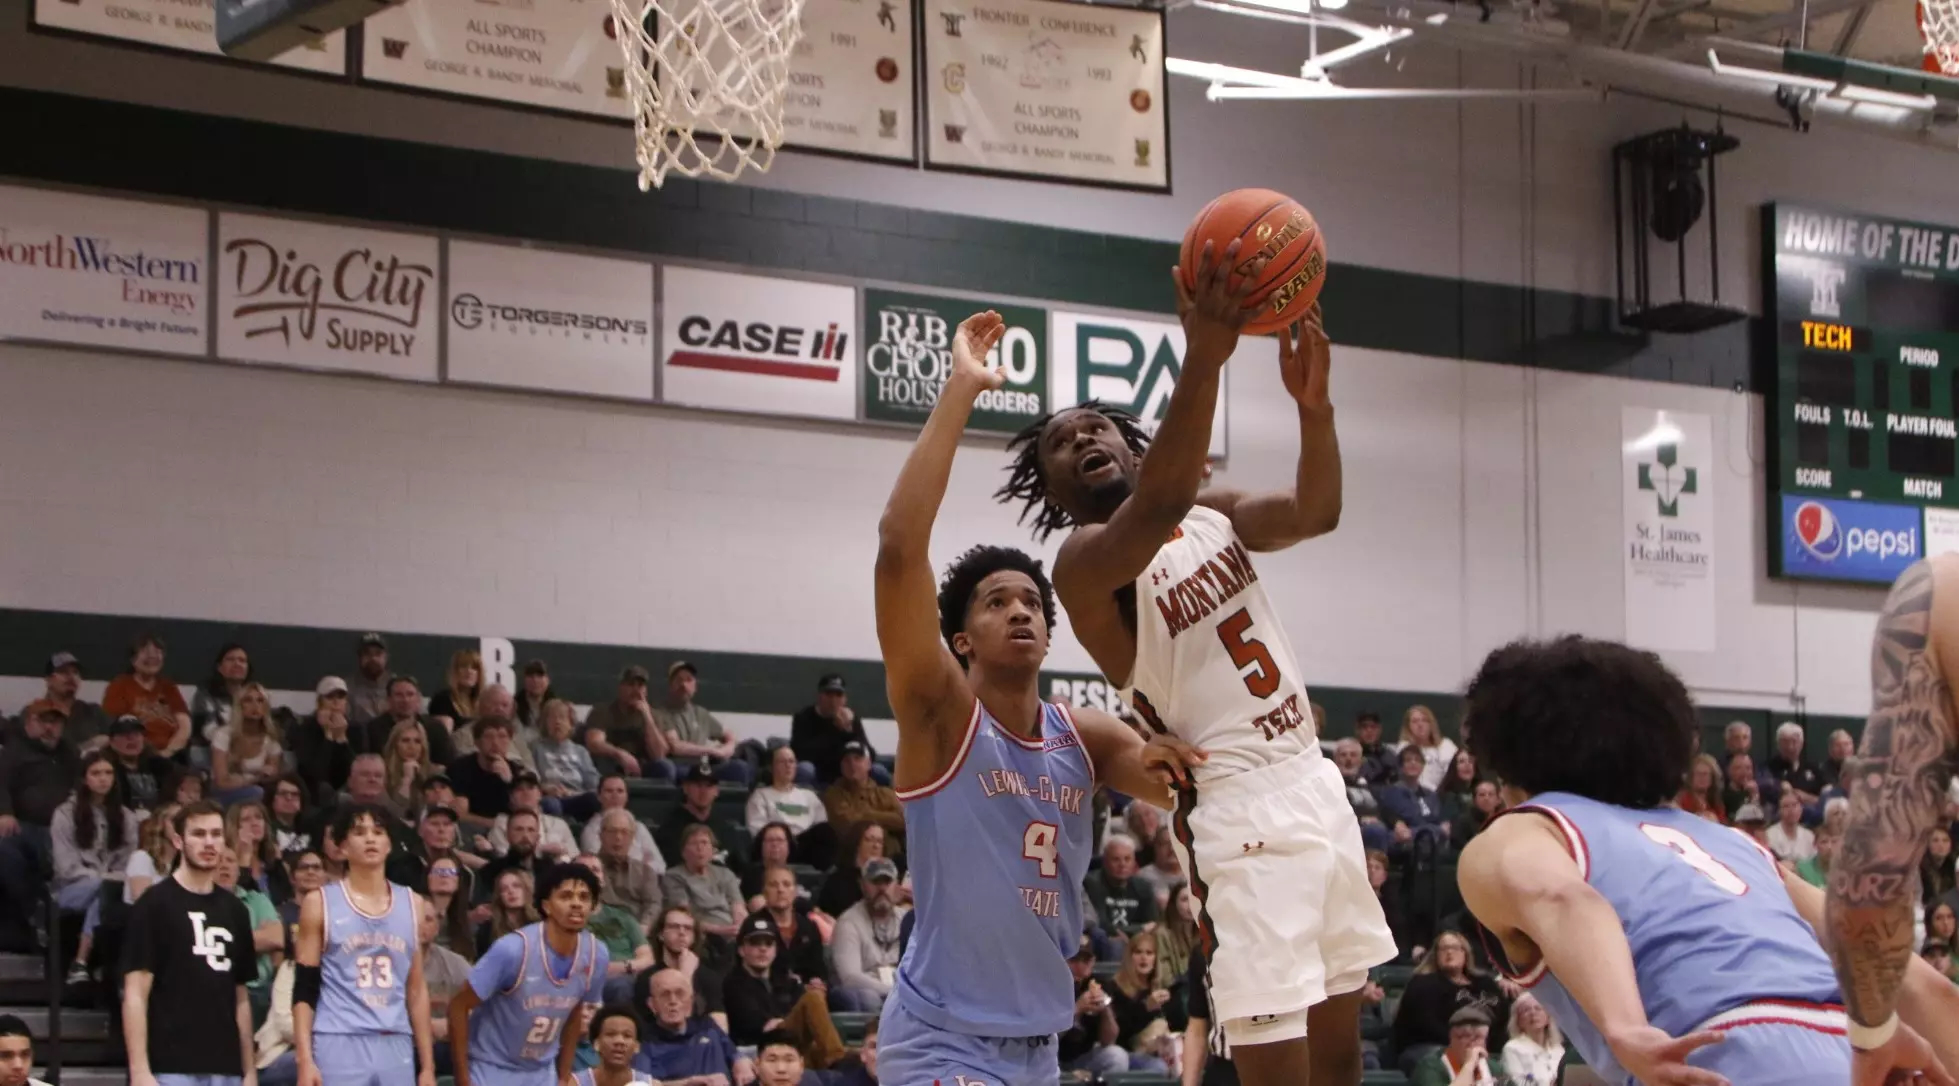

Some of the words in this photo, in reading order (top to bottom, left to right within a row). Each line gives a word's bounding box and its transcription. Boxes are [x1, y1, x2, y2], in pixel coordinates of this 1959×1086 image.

[466, 19, 490, 36] ALL
[494, 23, 546, 43] SPORTS
[973, 7, 1030, 27] FRONTIER
[1040, 16, 1118, 38] CONFERENCE
[466, 40, 542, 64] CHAMPION
[1014, 101, 1034, 117] ALL
[1038, 105, 1082, 122] SPORTS
[1014, 122, 1079, 140] CHAMPION
[1784, 211, 1859, 257] HOME
[1862, 222, 1894, 261] OF
[1898, 227, 1943, 269] THE
[121, 278, 196, 316] Energy
[226, 238, 322, 340] Dig
[333, 247, 433, 328] City
[326, 317, 415, 356] SUPPLY
[486, 304, 649, 336] TORGERSON'S
[678, 314, 804, 357] CASE
[1801, 320, 1852, 351] TECH
[1900, 345, 1939, 368] PERIOD
[1794, 403, 1832, 426] FOULS
[1886, 412, 1929, 436] PLAYER
[1795, 466, 1832, 489] SCORE
[1903, 478, 1942, 500] MATCH
[1636, 522, 1655, 540] St.
[1658, 523, 1702, 547] James
[1847, 526, 1915, 563] pepsi
[1630, 542, 1709, 566] Healthcare
[1155, 540, 1258, 640] MONTANA
[1216, 606, 1281, 700] 5
[1252, 694, 1304, 742] TECH
[1022, 820, 1058, 878] 4
[1638, 821, 1750, 897] 3
[187, 911, 234, 972] LC
[355, 955, 394, 989] 33
[526, 1015, 561, 1045] 21
